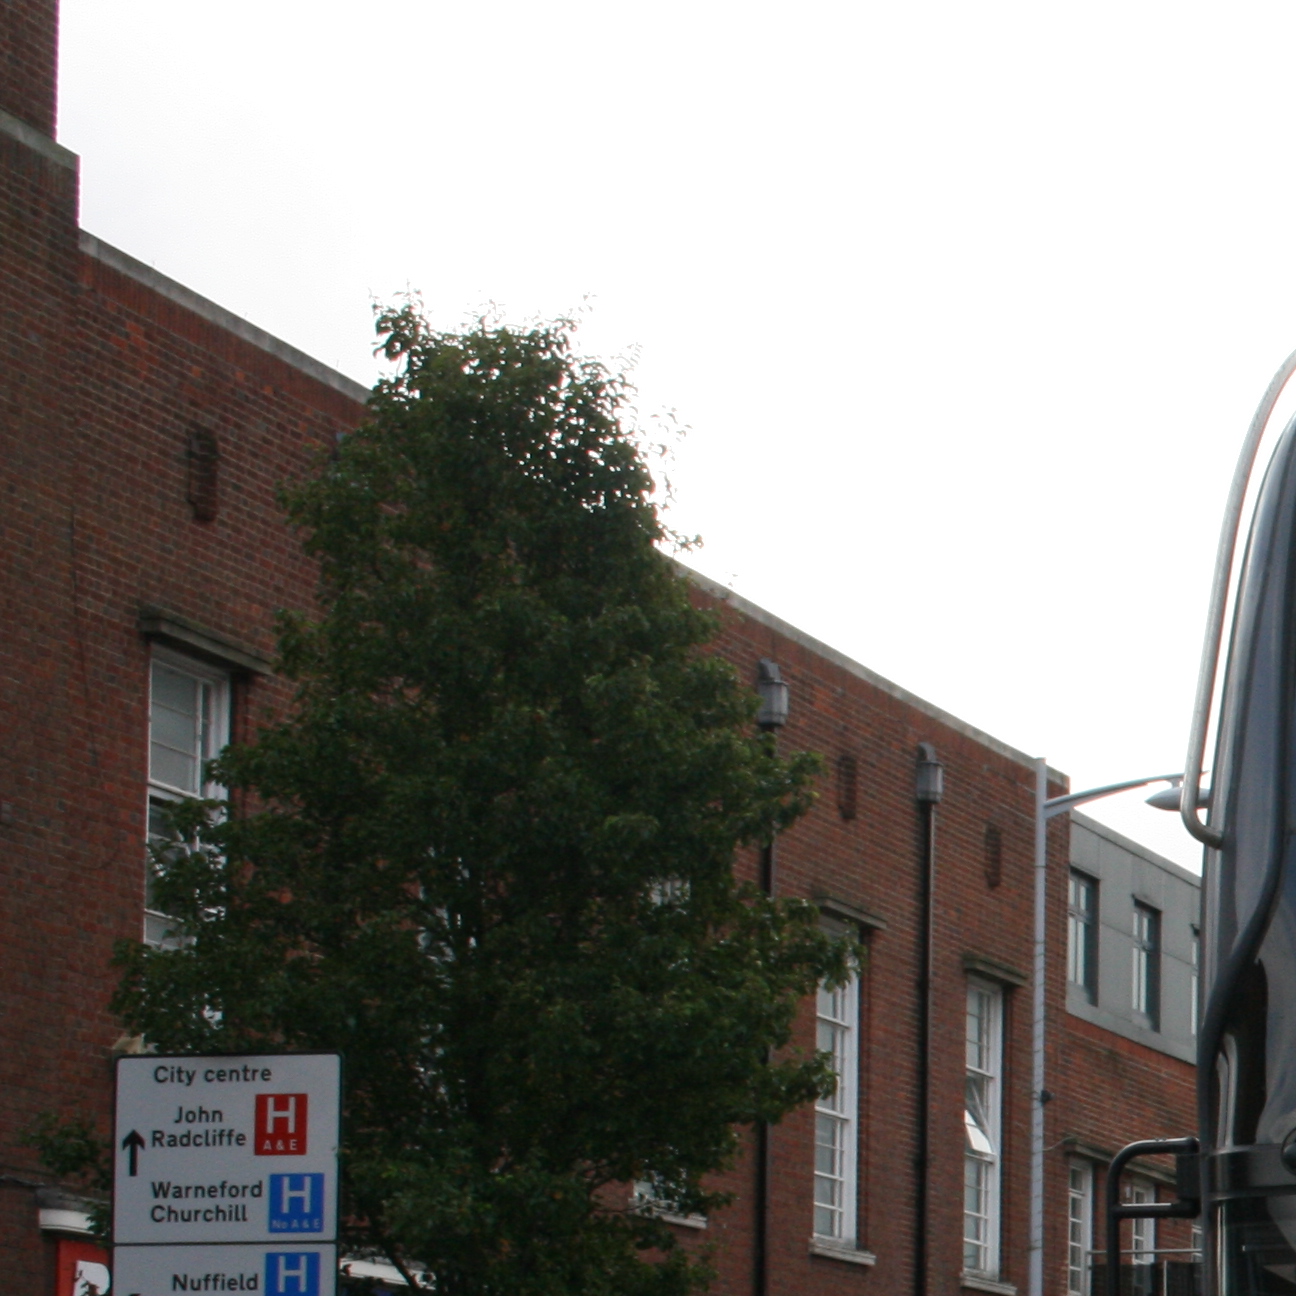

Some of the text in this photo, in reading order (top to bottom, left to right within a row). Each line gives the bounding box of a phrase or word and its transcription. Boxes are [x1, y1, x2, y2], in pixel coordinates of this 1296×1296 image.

[154, 1066, 272, 1086] City centre
[174, 1106, 223, 1123] John
[267, 1096, 296, 1134] H
[152, 1129, 246, 1147] Radcliffe
[263, 1139, 298, 1151] A & E
[152, 1181, 263, 1199] Warneford
[281, 1176, 312, 1214] H
[151, 1205, 248, 1223] Churchill
[172, 1273, 259, 1292] Nuffield
[278, 1255, 308, 1293] H
